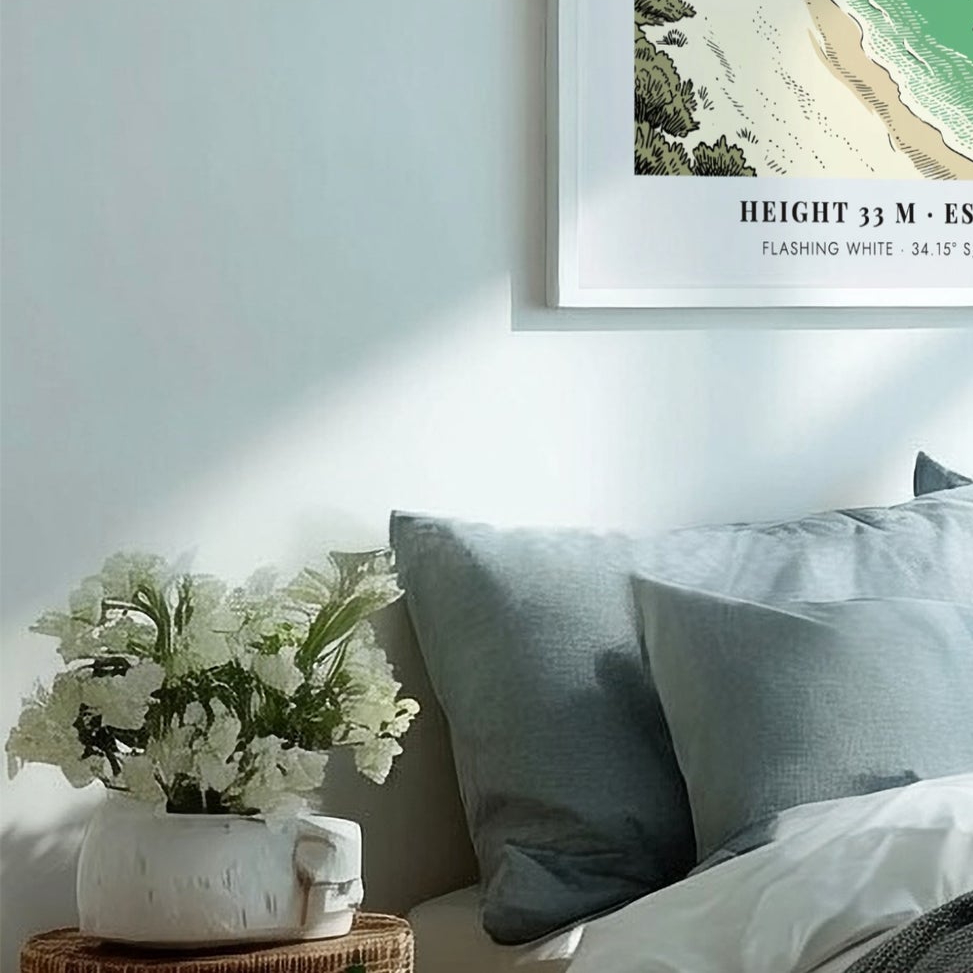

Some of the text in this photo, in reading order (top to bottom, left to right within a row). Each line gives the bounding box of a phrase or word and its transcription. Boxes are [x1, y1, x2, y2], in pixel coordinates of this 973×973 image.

[739, 200, 849, 224] HEIGHT
[859, 206, 885, 228] 33
[895, 202, 916, 224] M
[762, 240, 840, 257] FLASHING
[846, 241, 893, 257] WHITE
